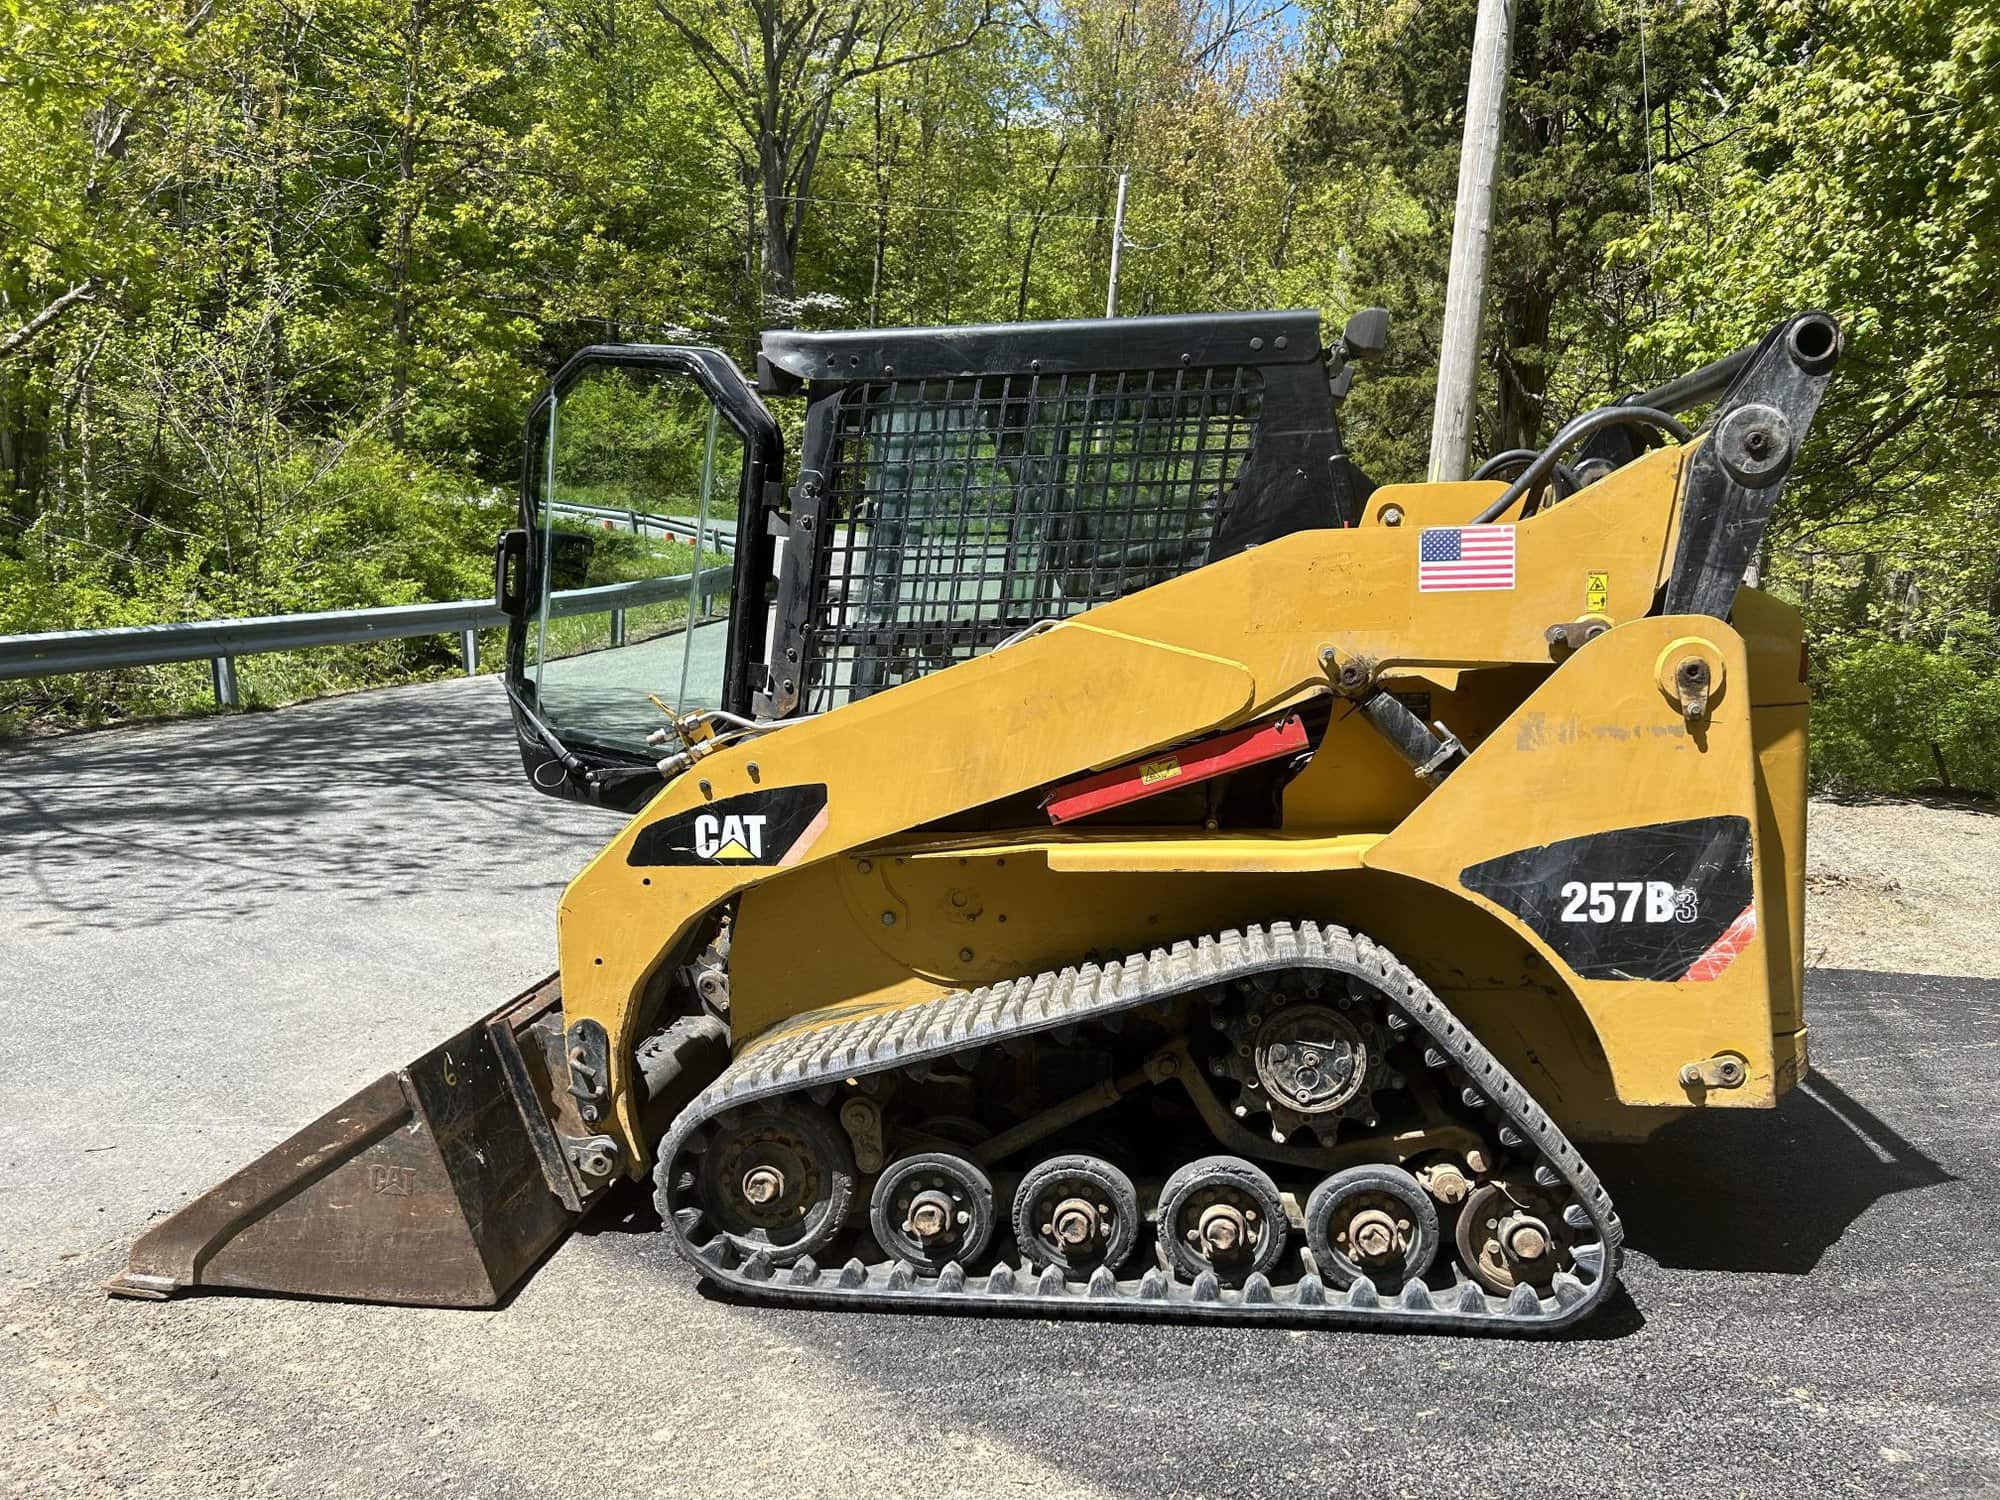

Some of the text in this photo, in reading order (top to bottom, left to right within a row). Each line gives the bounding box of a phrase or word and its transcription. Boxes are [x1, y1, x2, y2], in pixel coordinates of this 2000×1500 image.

[694, 814, 767, 859] CAT
[1560, 881, 1698, 924] 257B3
[367, 1163, 417, 1197] CAT
